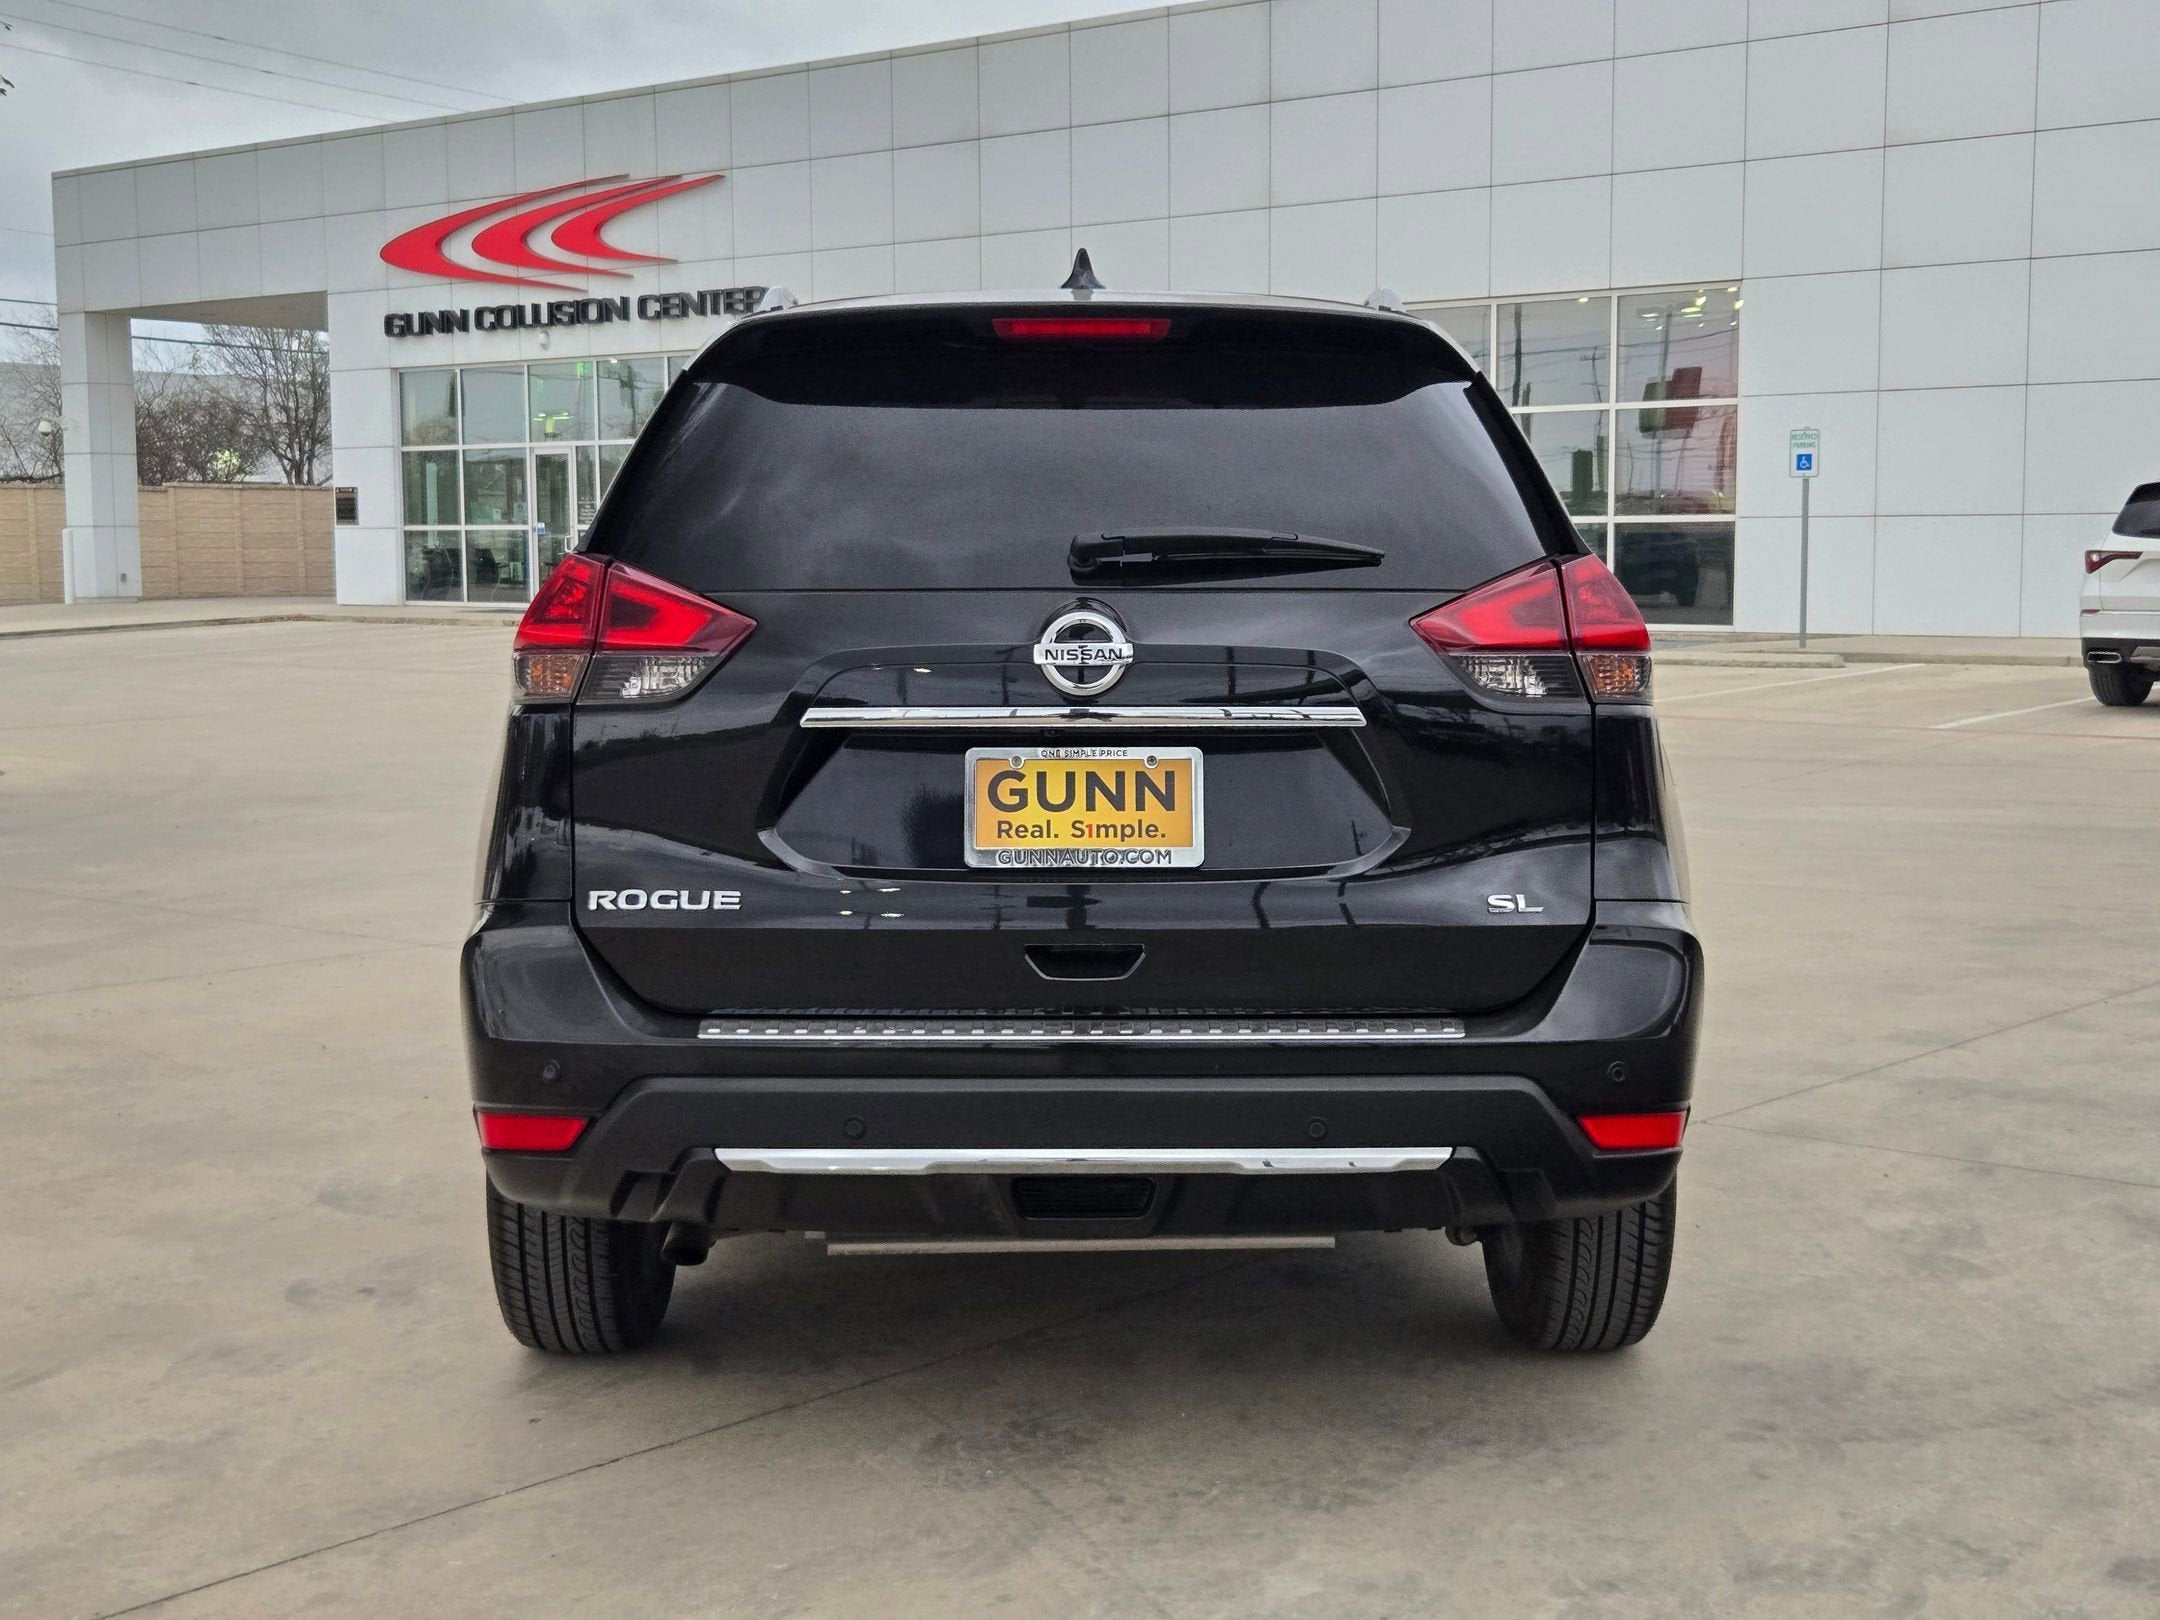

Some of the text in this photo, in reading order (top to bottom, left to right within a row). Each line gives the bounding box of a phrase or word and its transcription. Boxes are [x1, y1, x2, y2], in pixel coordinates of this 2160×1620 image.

[384, 286, 768, 338] GUNN COLLISION CENTER
[1791, 432, 1817, 441] RESERVED
[1045, 648, 1122, 661] NISSAN
[1040, 749, 1129, 758] ONE SIMPLE PRICE
[987, 770, 1176, 813] GUNN
[997, 819, 1167, 842] Real. S1mple.
[997, 849, 1173, 865] GUNNAUTO.COM
[588, 889, 742, 911] ROGUE
[1487, 894, 1545, 913] SL
